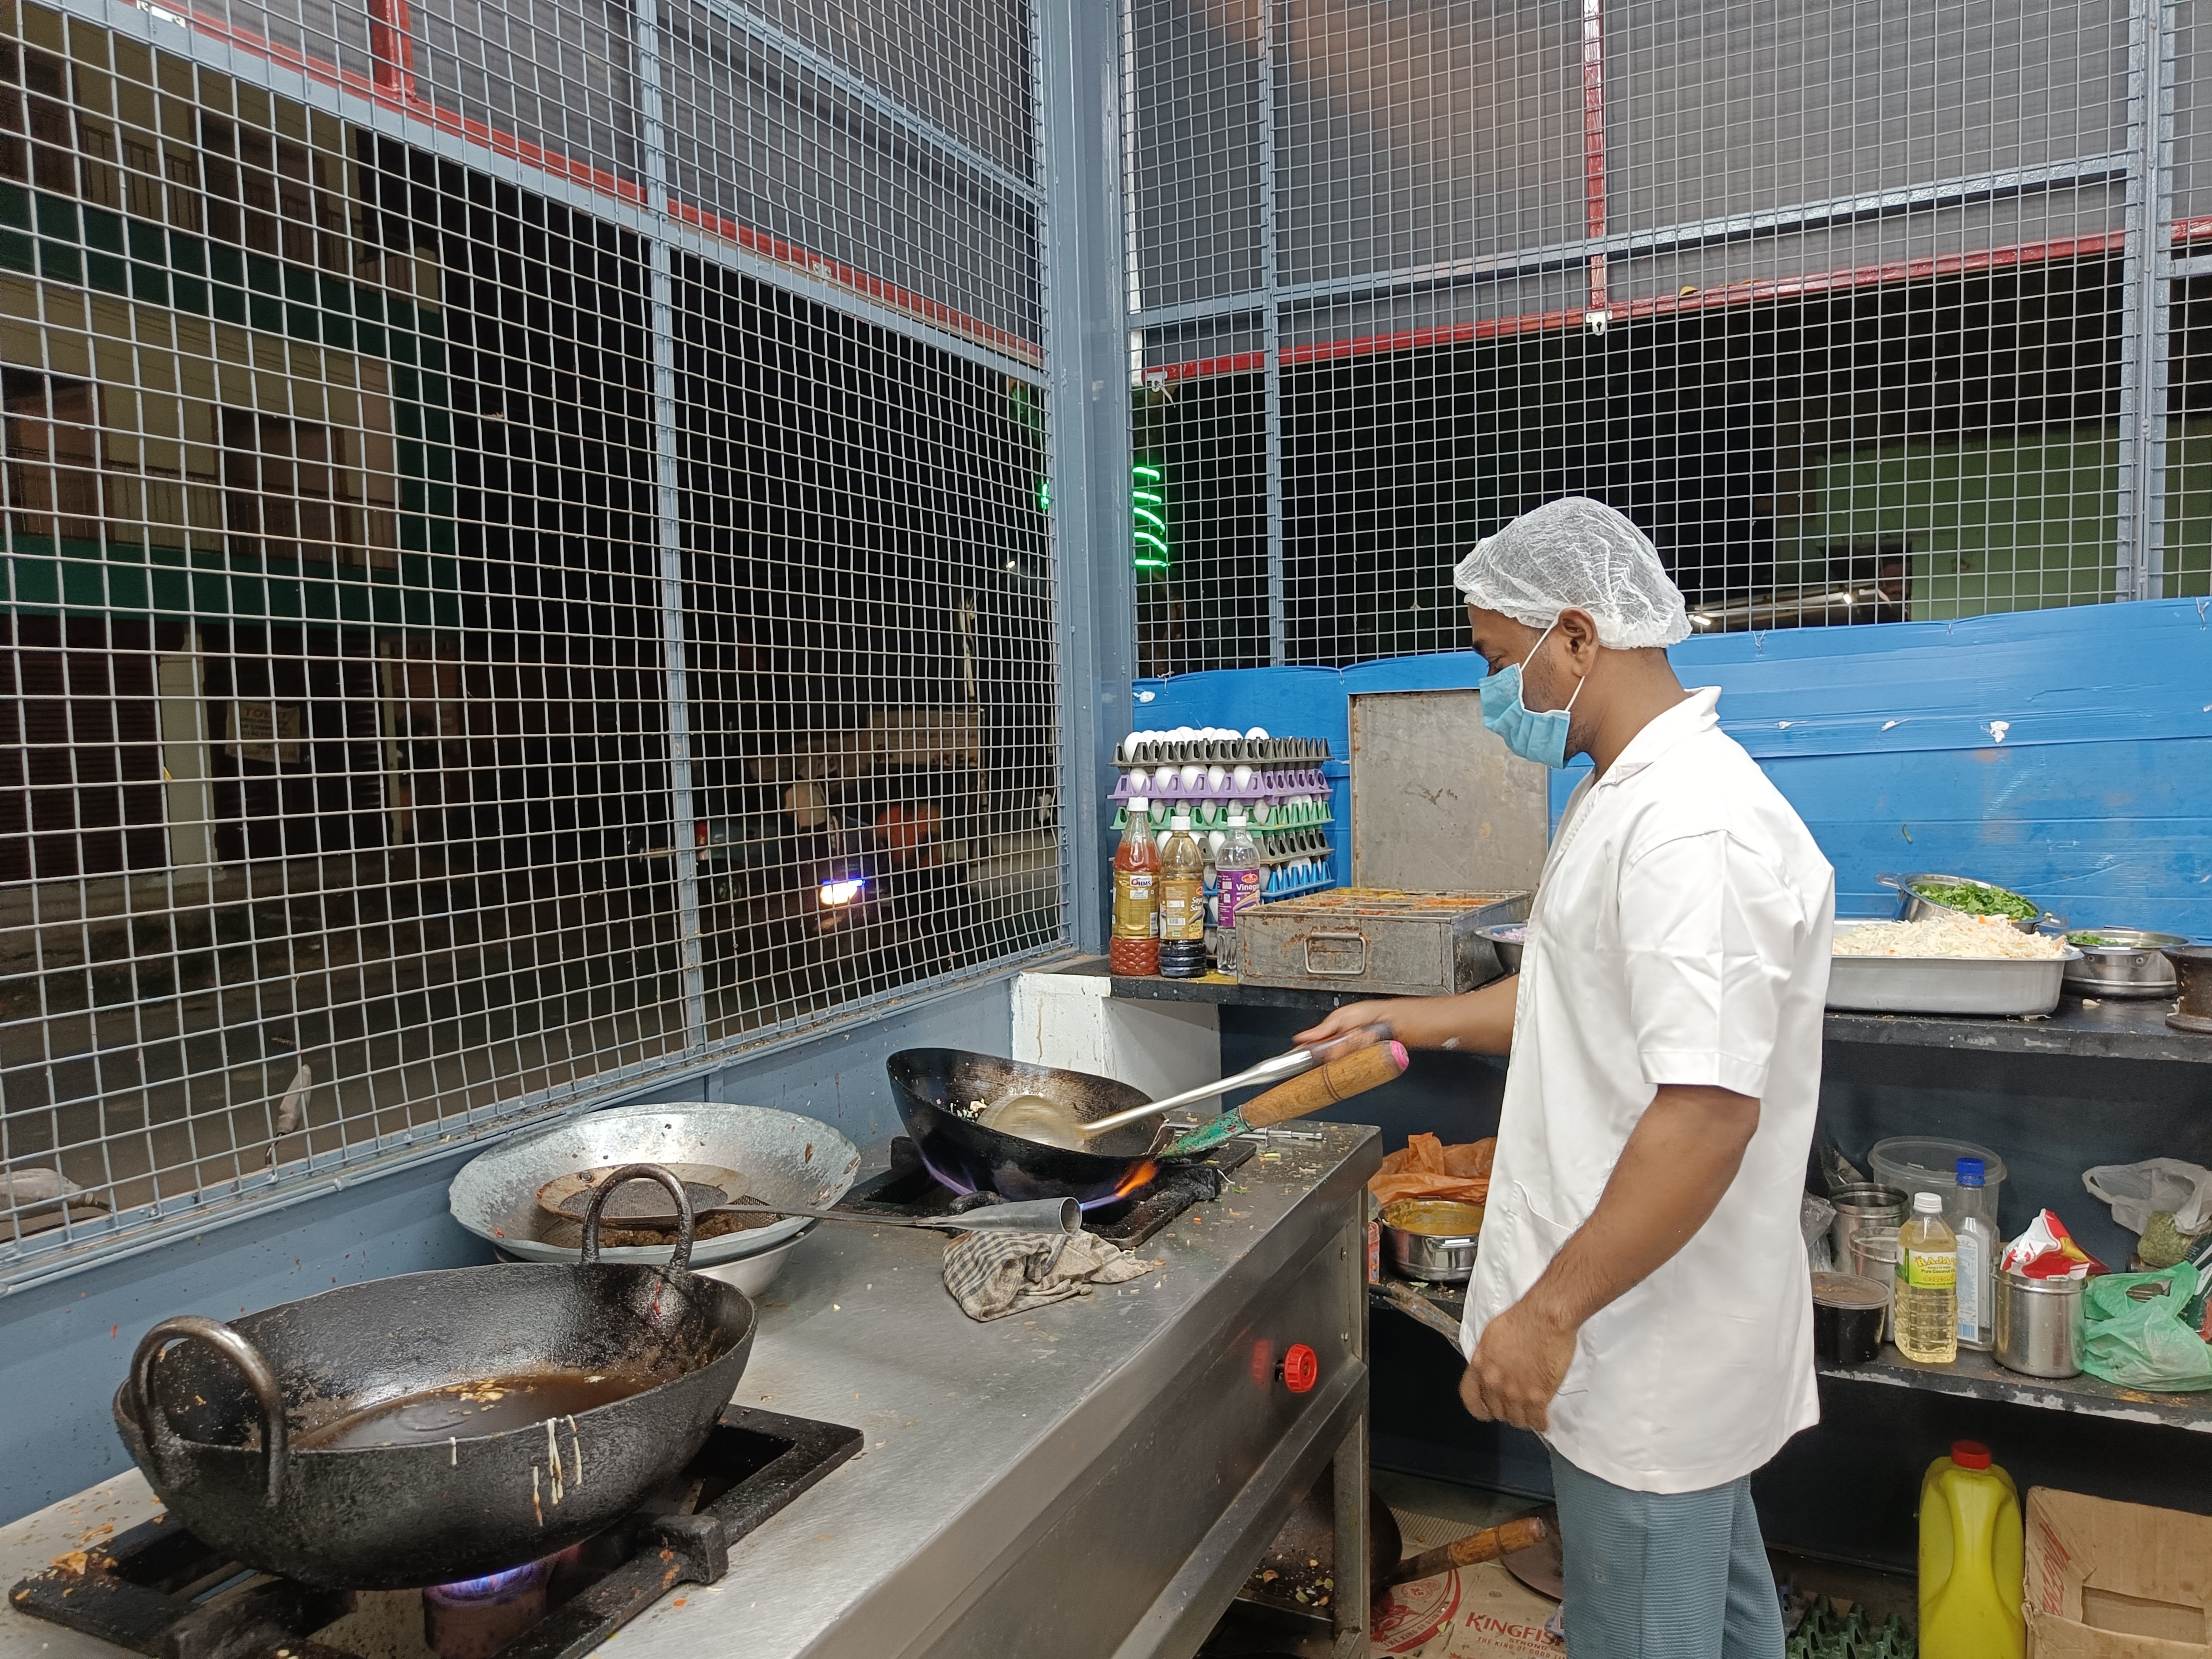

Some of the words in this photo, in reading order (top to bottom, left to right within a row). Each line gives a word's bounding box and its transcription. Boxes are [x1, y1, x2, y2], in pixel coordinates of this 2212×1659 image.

[1383, 1638, 1400, 1647] THE
[1399, 1629, 1418, 1640] KING
[1425, 1614, 1440, 1624] GOOD
[1465, 1612, 1565, 1646] KINGFIS
[1478, 1636, 1492, 1645] THE
[1495, 1640, 1513, 1650] KING
[1529, 1649, 1550, 1658] GOOD
[1509, 1638, 1547, 1650] STRONG
